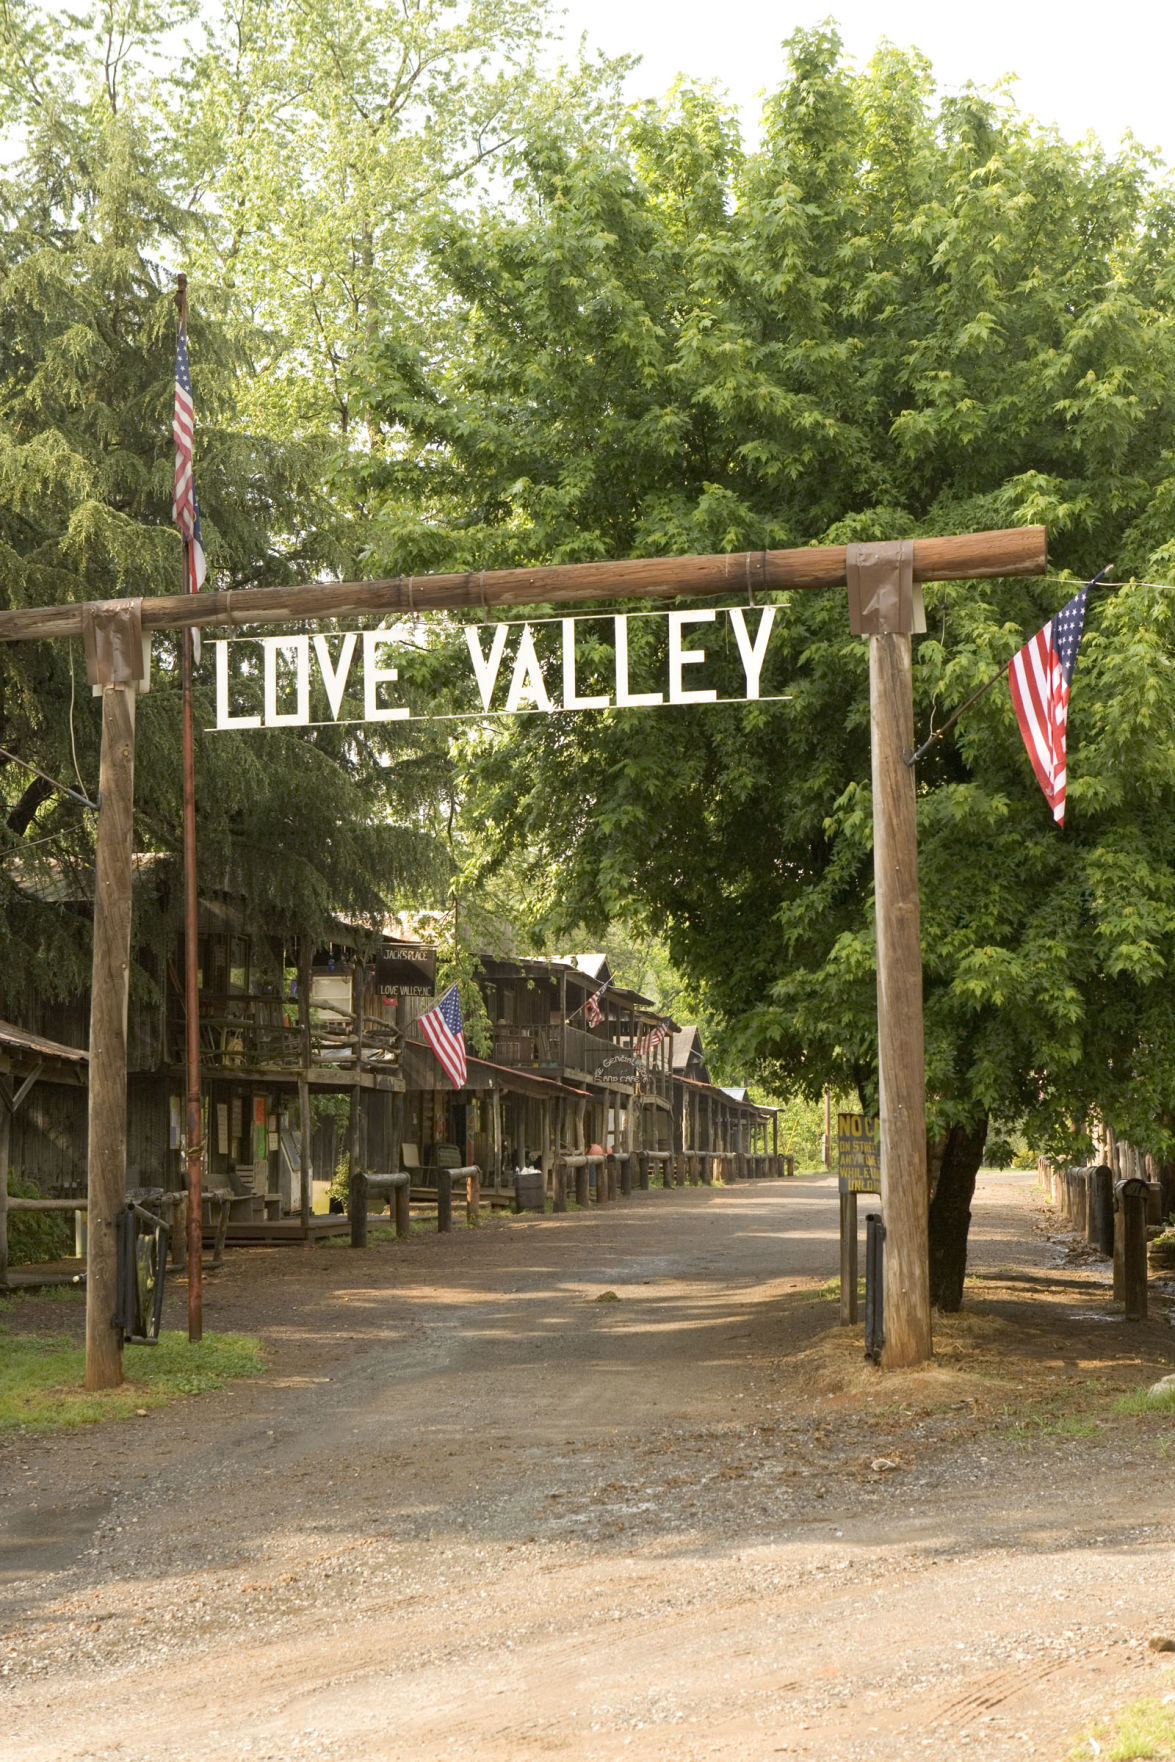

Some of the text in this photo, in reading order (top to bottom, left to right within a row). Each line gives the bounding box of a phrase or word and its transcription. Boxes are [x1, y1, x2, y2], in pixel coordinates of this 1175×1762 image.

[215, 607, 777, 729] LOVE VALLEY
[407, 950, 428, 961] PLACE
[380, 985, 399, 995] LOVE
[839, 1115, 863, 1137] NO
[839, 1141, 850, 1153] ON
[840, 1167, 870, 1178] WHILE
